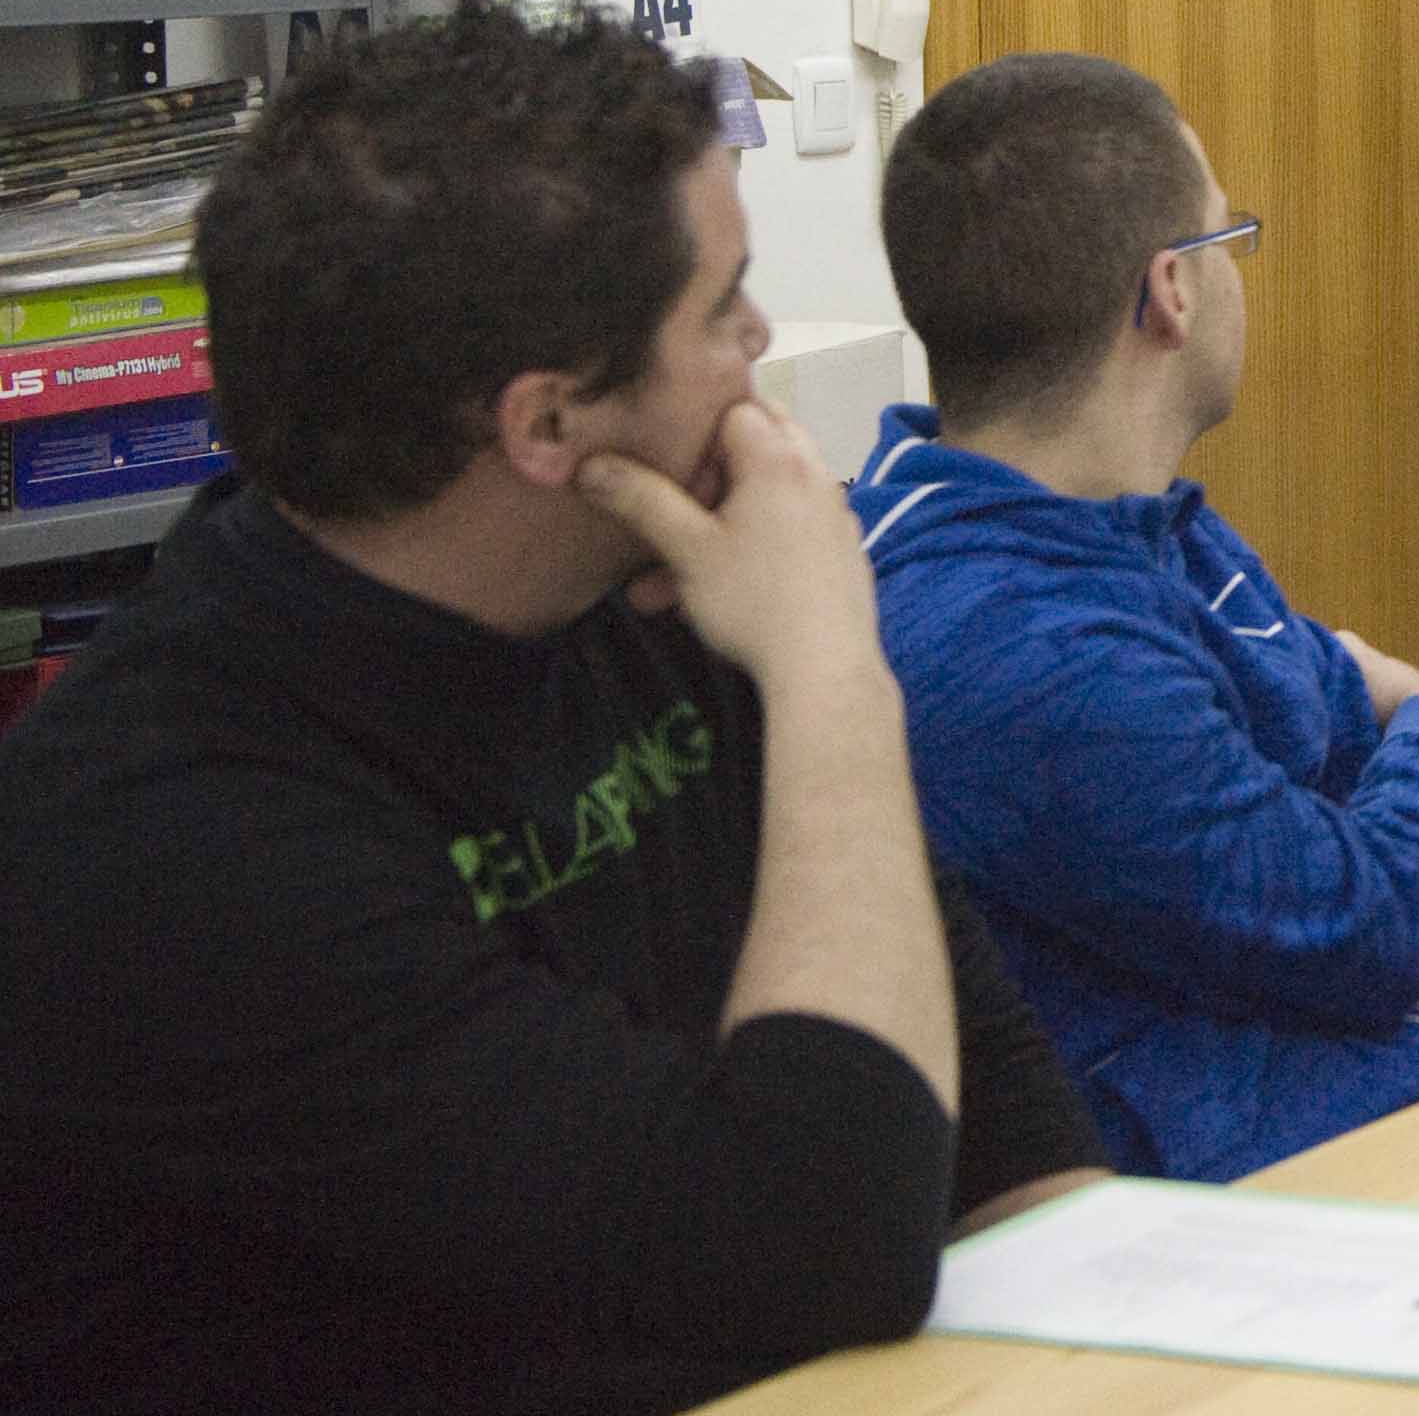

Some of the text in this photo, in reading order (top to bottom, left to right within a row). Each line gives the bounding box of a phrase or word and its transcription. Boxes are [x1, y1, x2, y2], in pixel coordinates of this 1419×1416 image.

[0, 352, 181, 399] US My Cinema-P7131 Hybrid
